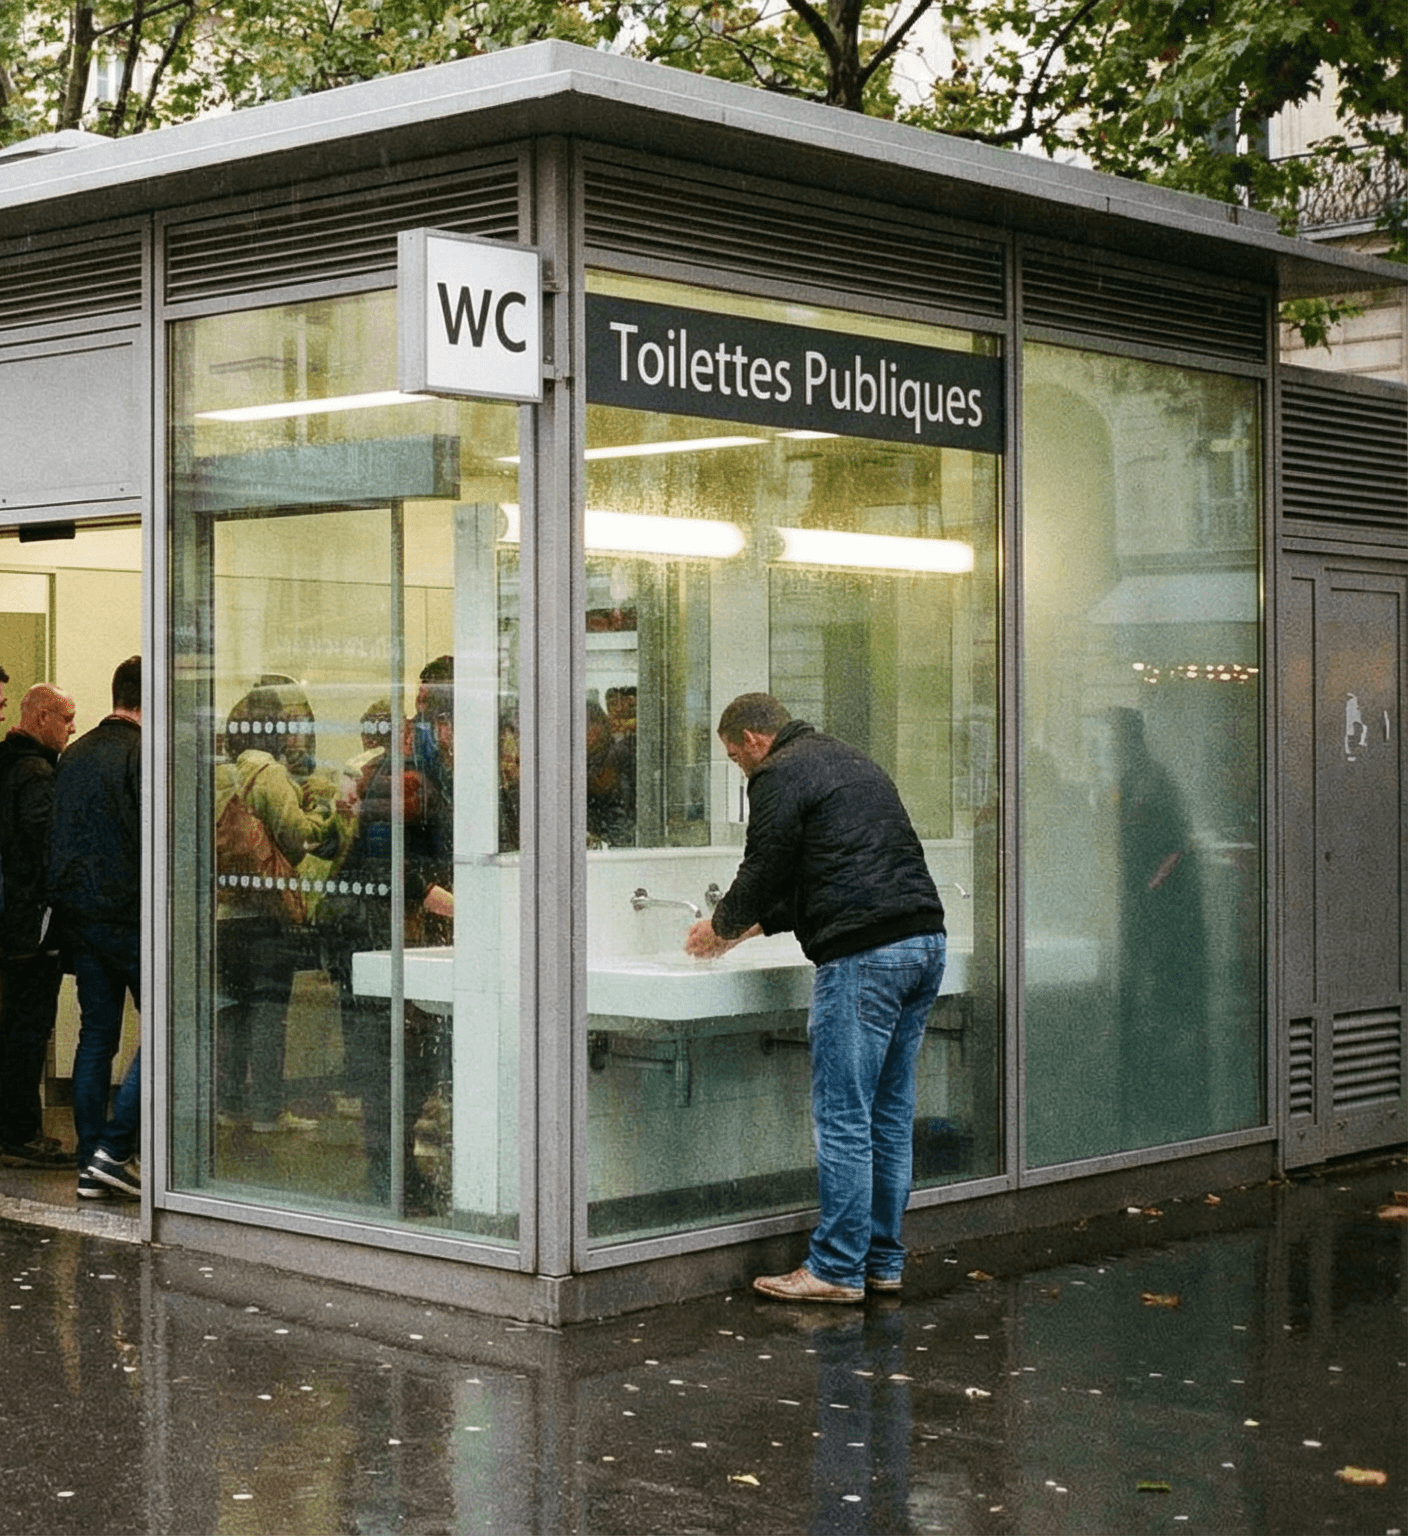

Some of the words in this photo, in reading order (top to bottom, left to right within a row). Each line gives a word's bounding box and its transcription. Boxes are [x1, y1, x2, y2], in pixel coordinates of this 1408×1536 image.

[437, 282, 526, 353] WC
[609, 321, 792, 403] Toilettes
[805, 350, 983, 434] Publiques
